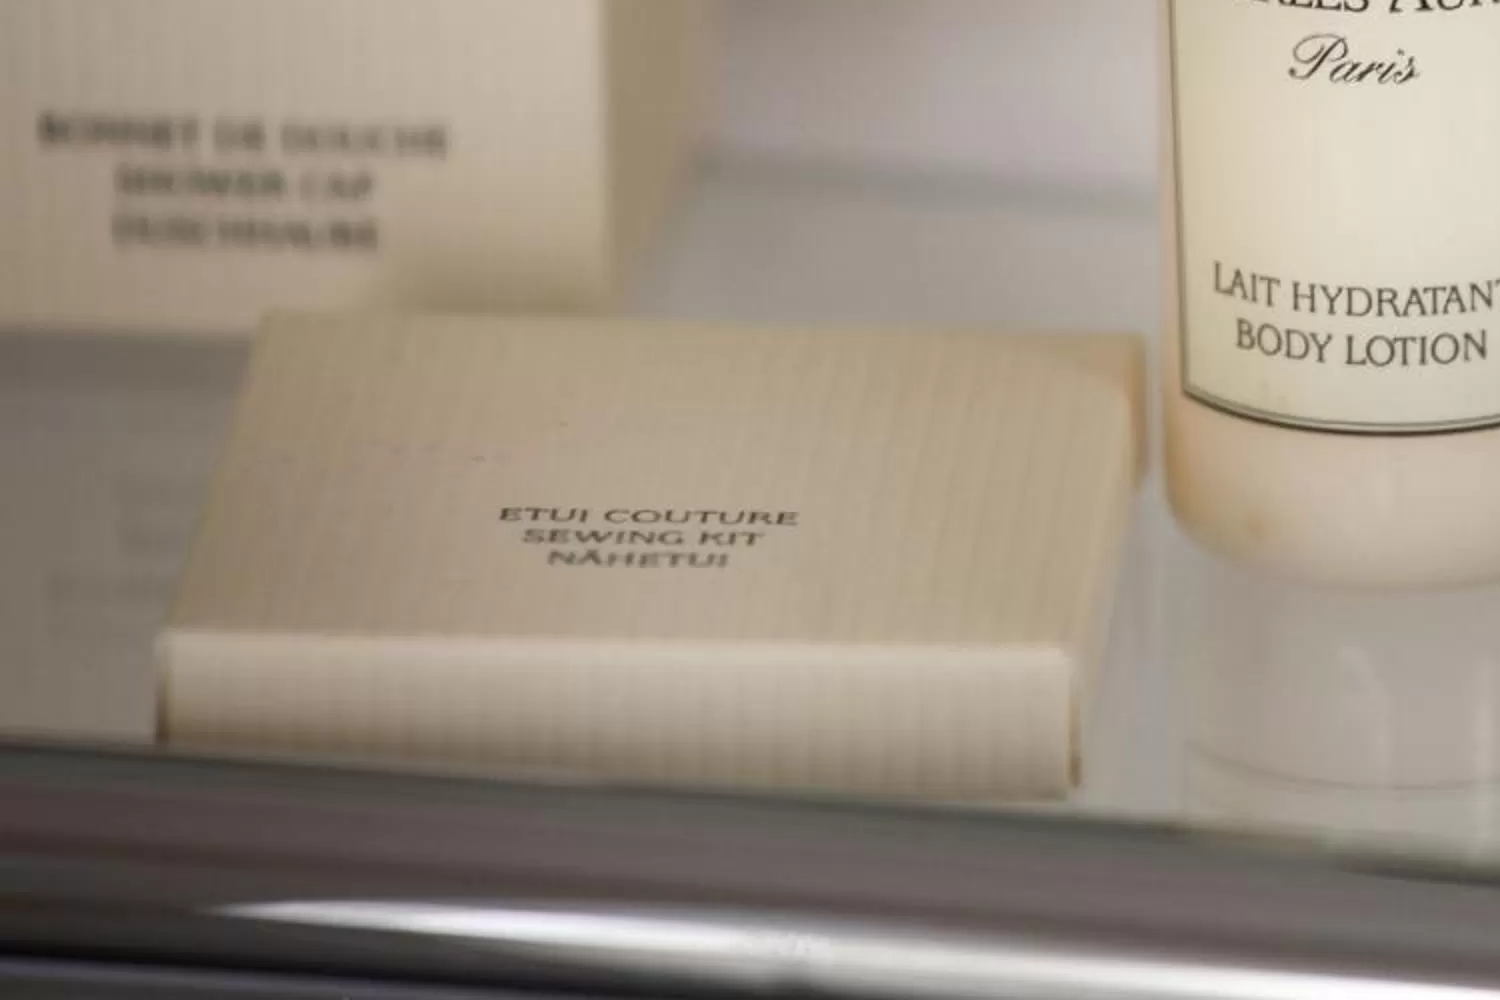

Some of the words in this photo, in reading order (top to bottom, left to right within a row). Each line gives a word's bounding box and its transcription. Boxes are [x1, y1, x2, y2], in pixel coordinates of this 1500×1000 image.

[1288, 33, 1420, 85] Paris
[1213, 261, 1280, 308] LAIT
[1236, 317, 1333, 365] BODY
[1345, 330, 1488, 367] LOTION
[499, 507, 589, 523] ETUI
[604, 509, 800, 526] COUTURE
[522, 529, 685, 545] SEWING
[699, 532, 765, 547] KIT
